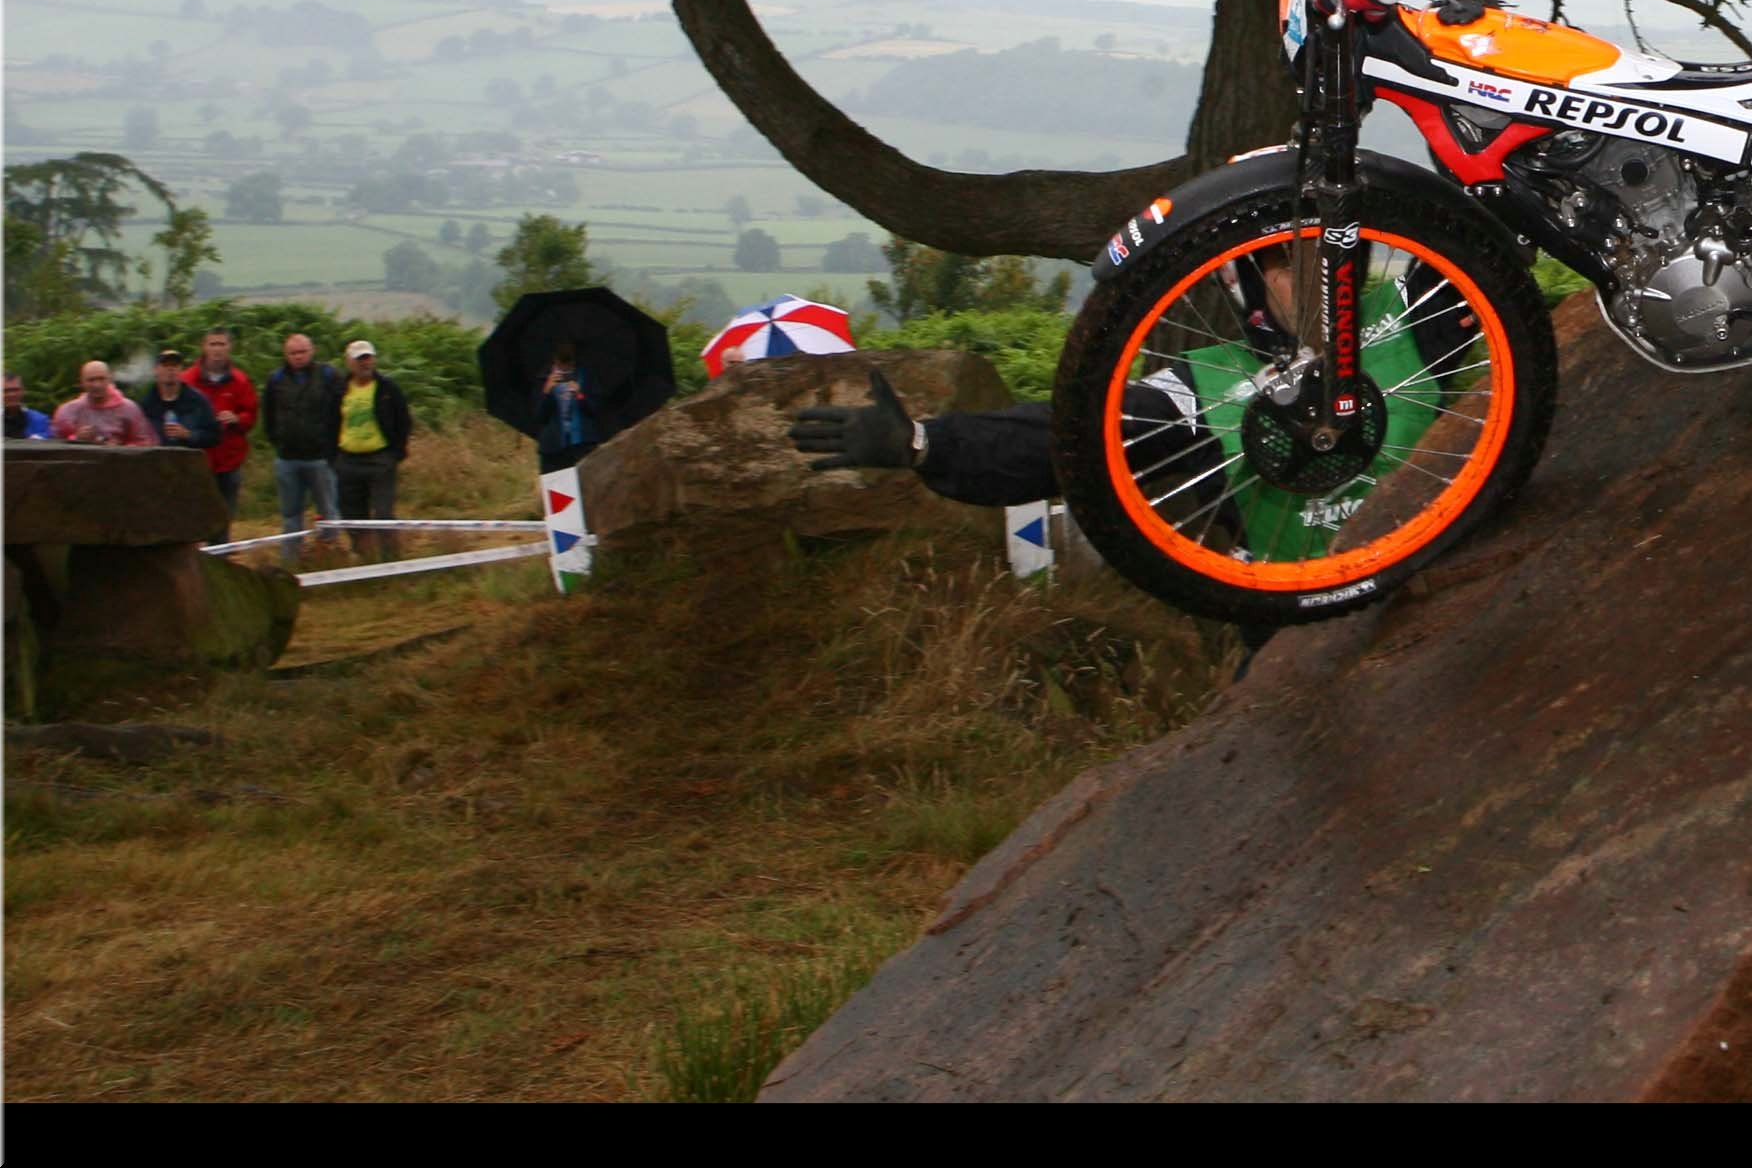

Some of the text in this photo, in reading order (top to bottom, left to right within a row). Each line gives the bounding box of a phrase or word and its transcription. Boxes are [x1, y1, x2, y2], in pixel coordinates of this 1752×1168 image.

[1467, 80, 1512, 103] HRC
[1523, 88, 1687, 144] REPSOL
[1324, 220, 1361, 248] S3
[1335, 262, 1355, 378] HONDA
